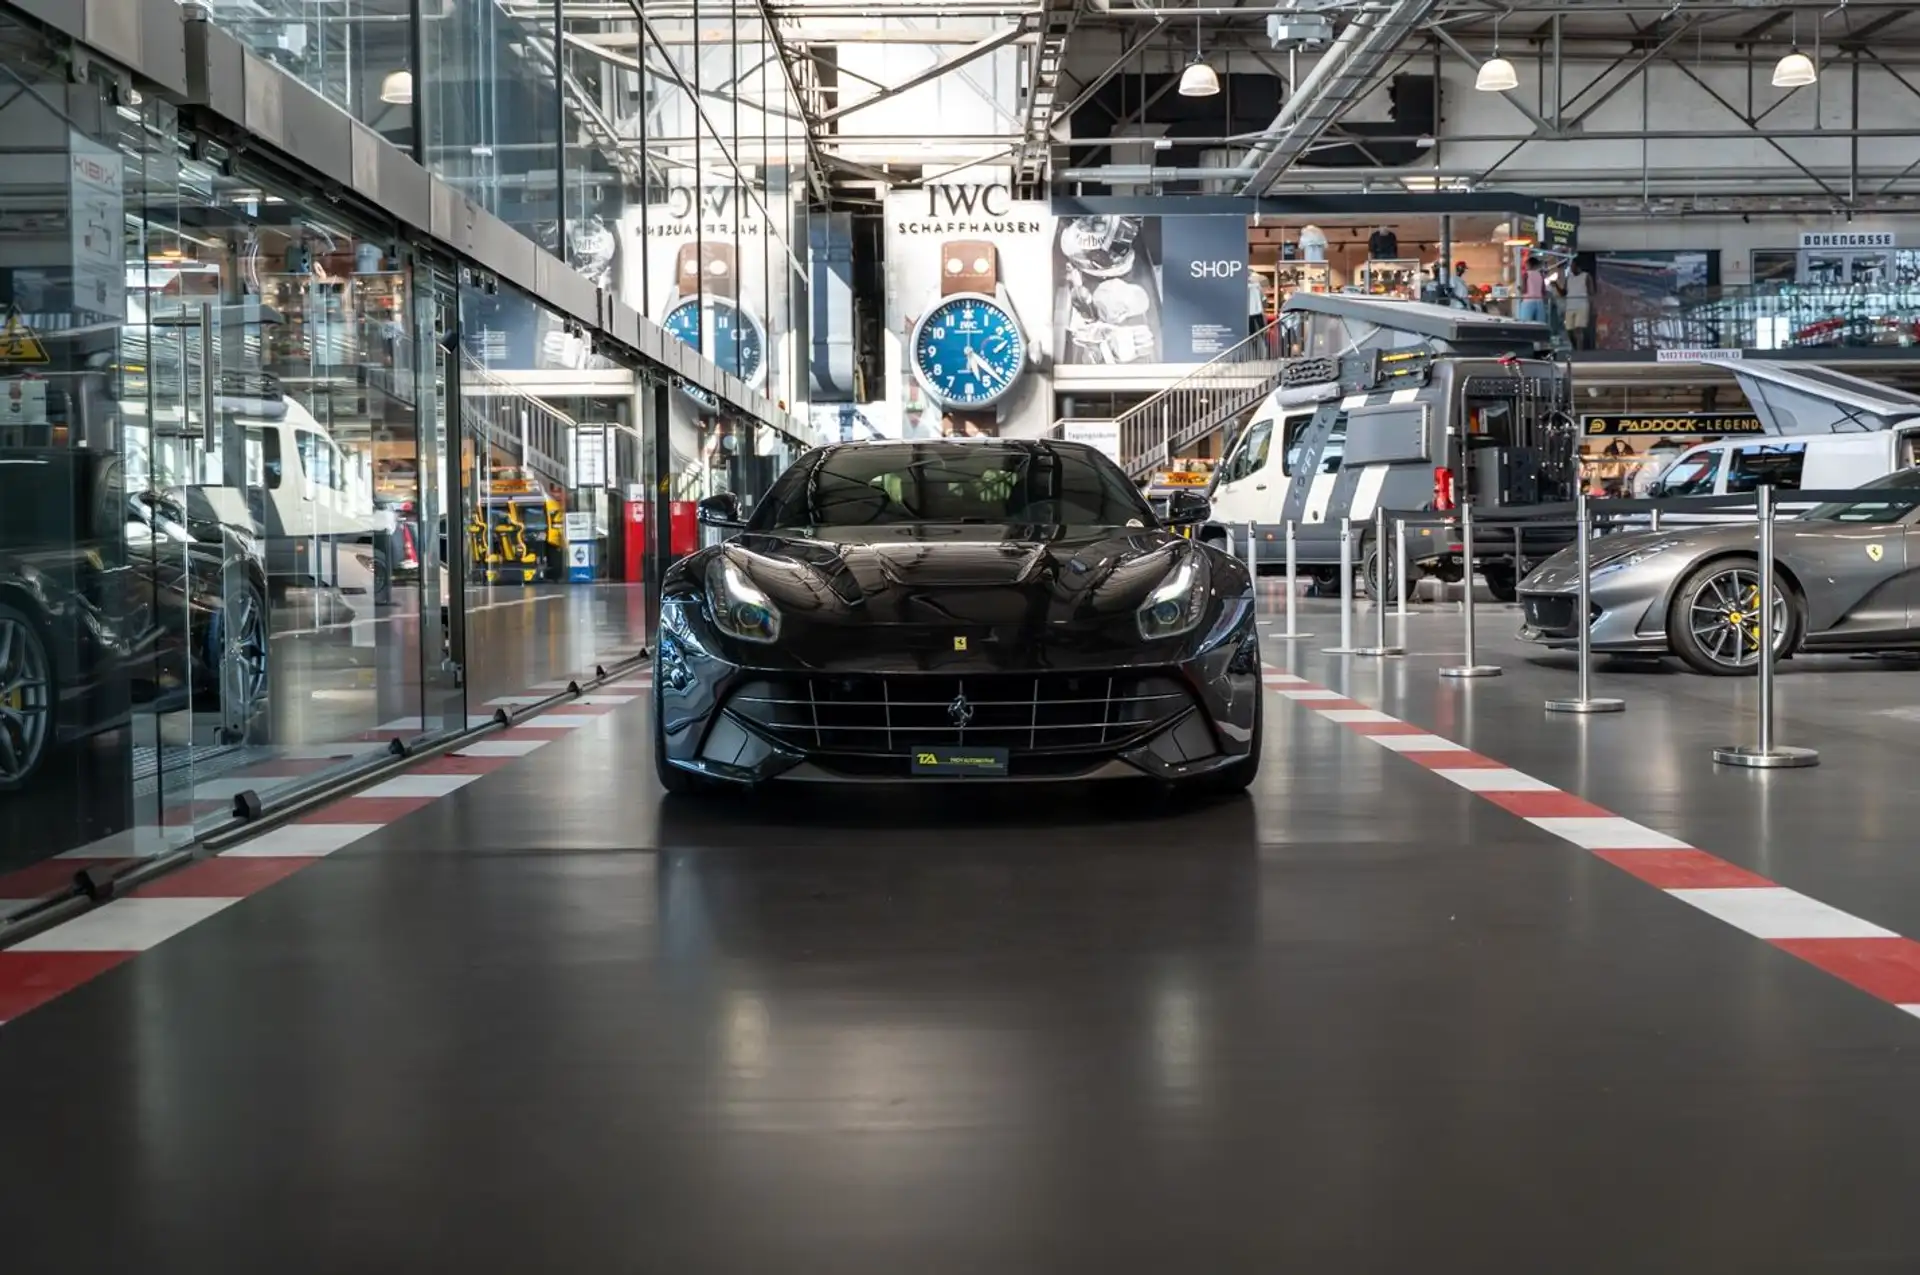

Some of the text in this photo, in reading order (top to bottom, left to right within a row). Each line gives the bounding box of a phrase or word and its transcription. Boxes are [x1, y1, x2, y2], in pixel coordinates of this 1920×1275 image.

[925, 183, 1009, 217] IWC
[899, 222, 1040, 234] SCHAFFHAUSEN
[1190, 260, 1242, 278] SHOP
[932, 327, 945, 340] 10
[927, 345, 936, 358] 9
[1660, 350, 1740, 360] MOTORWORLD
[933, 364, 942, 376] 8
[946, 376, 955, 388] 7
[982, 376, 991, 388] 5
[917, 753, 938, 764] TA
